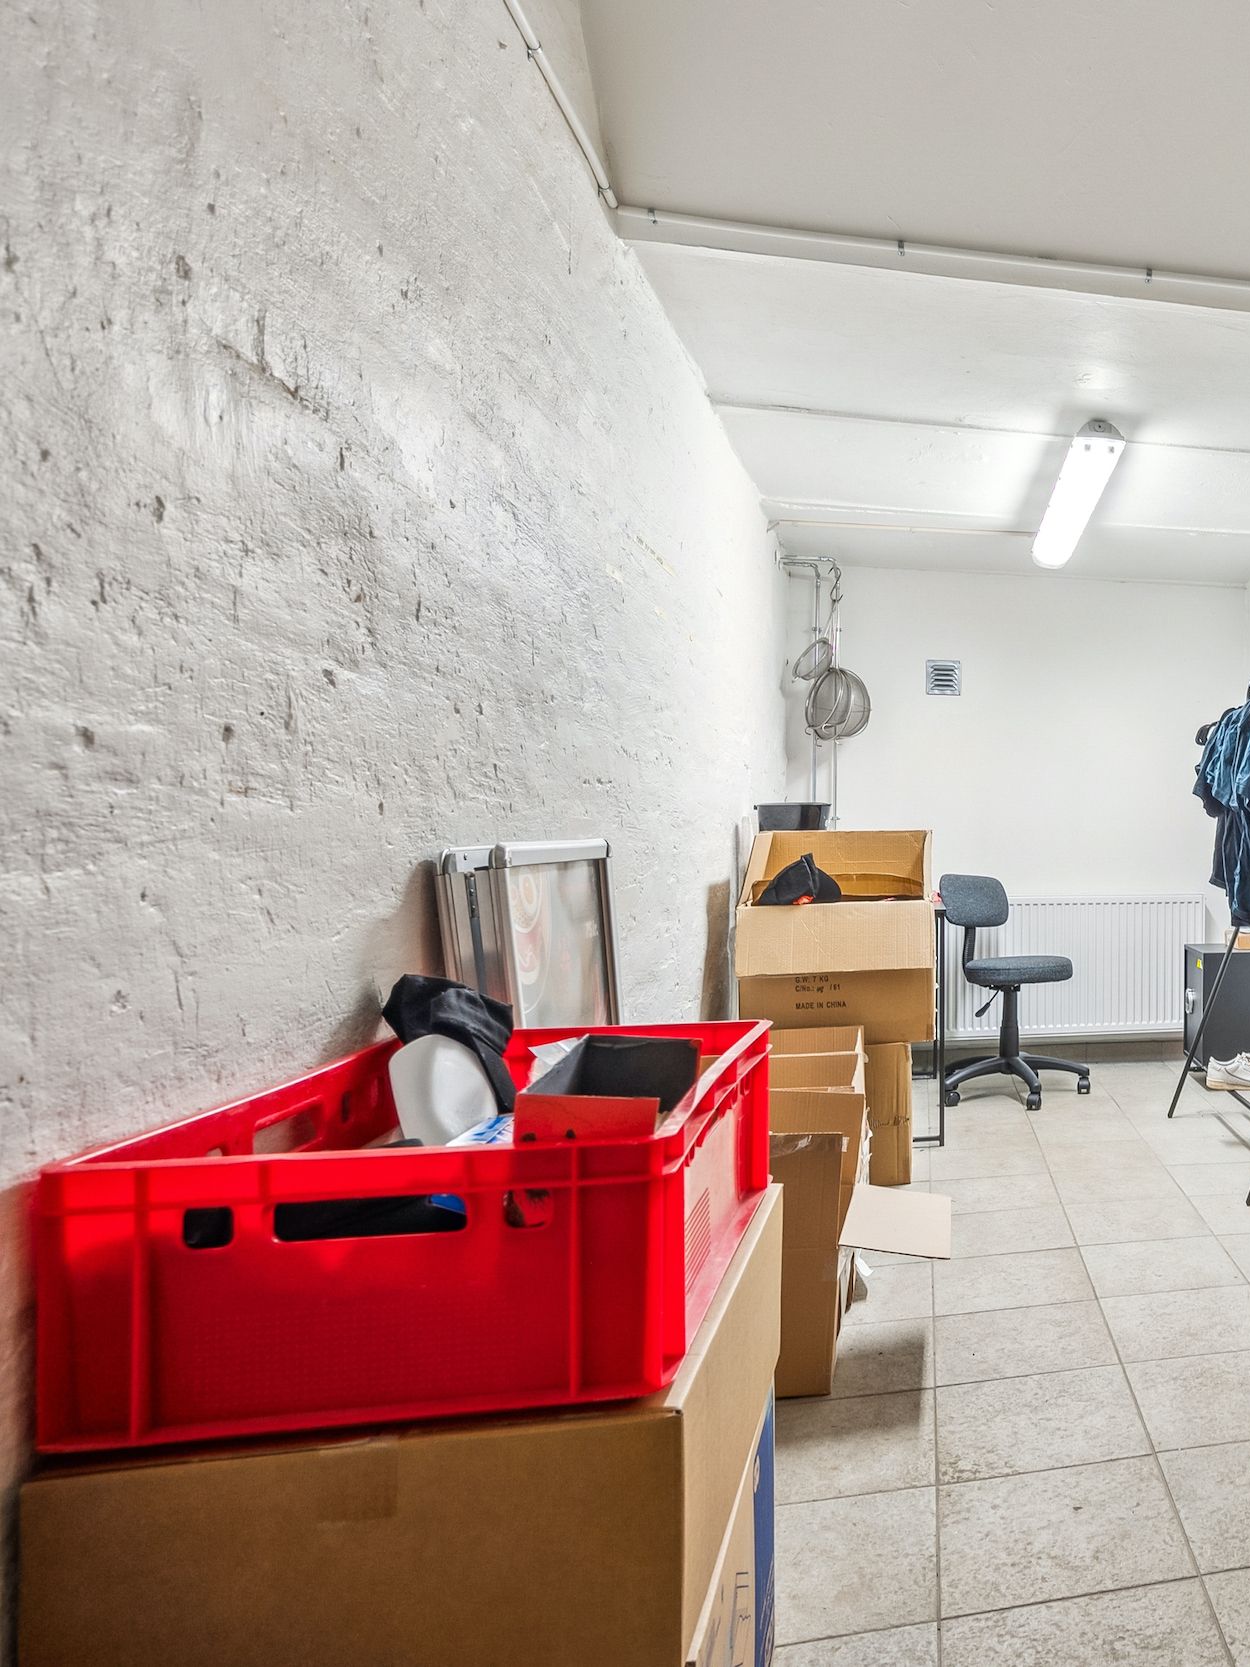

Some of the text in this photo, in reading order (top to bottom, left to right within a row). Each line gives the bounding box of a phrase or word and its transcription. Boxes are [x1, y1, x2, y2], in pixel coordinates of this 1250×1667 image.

[795, 1001, 847, 1010] MADE IN CHINA
